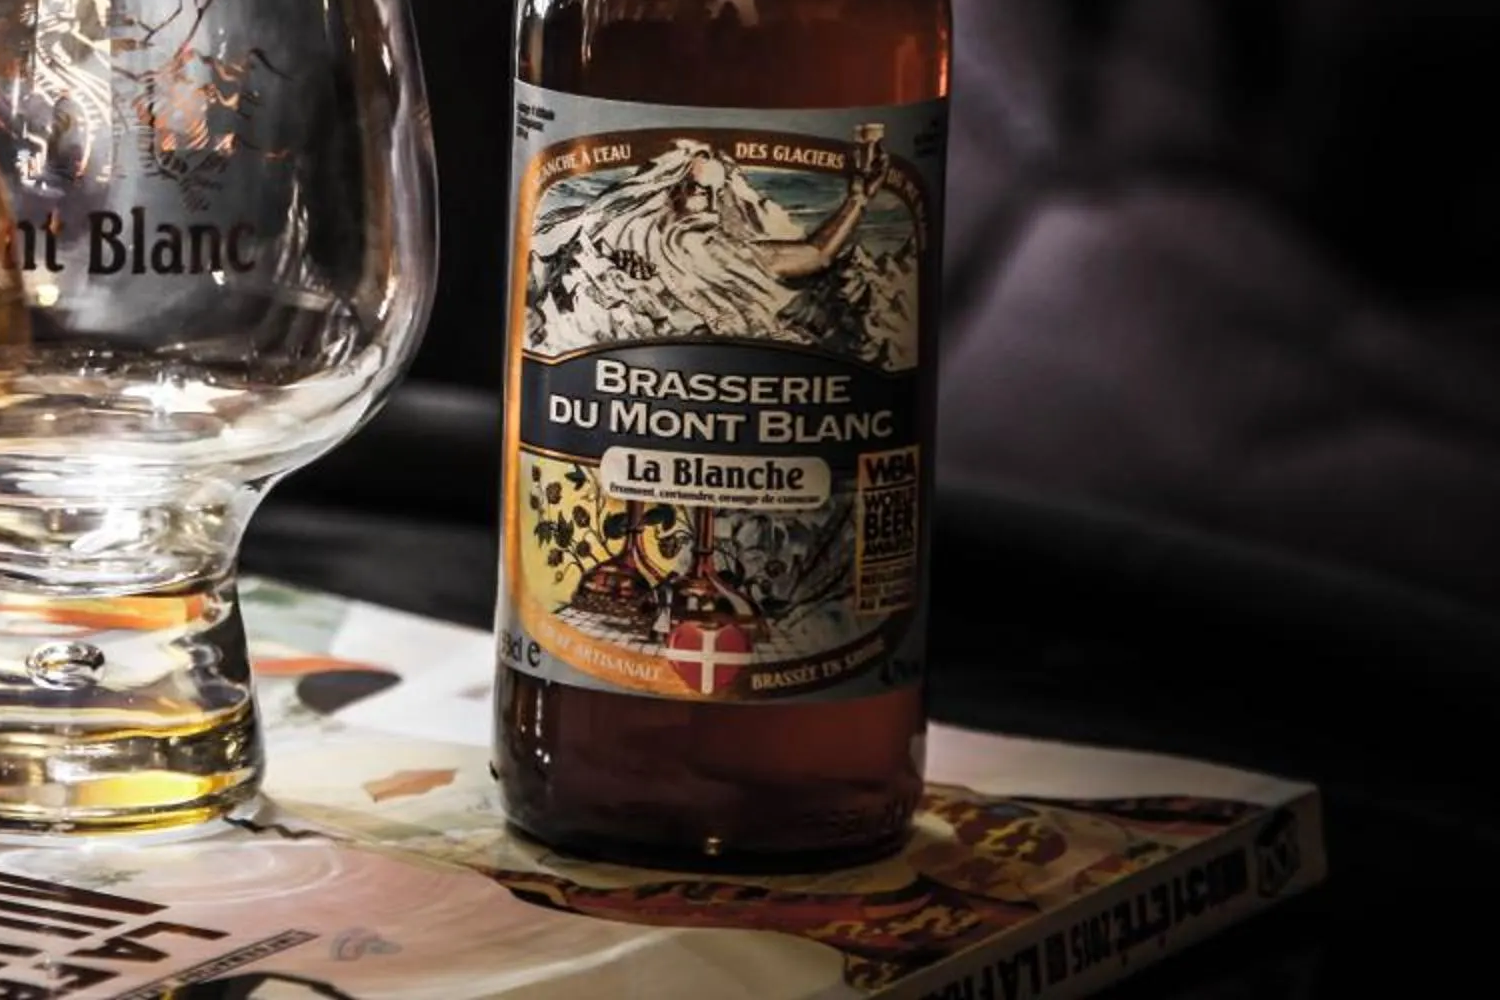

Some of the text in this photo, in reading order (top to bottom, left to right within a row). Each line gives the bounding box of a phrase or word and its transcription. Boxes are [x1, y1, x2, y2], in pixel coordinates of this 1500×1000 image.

[593, 143, 632, 164] L'EAU
[735, 142, 766, 160] DES
[773, 145, 845, 170] GLACIERS
[87, 207, 257, 276] Blanc
[595, 359, 852, 405] BRASSERIE
[548, 395, 894, 444] DU MONT BLANC
[627, 454, 804, 490] La Blanche
[865, 509, 914, 541] BEER
[68, 921, 230, 962] LA
